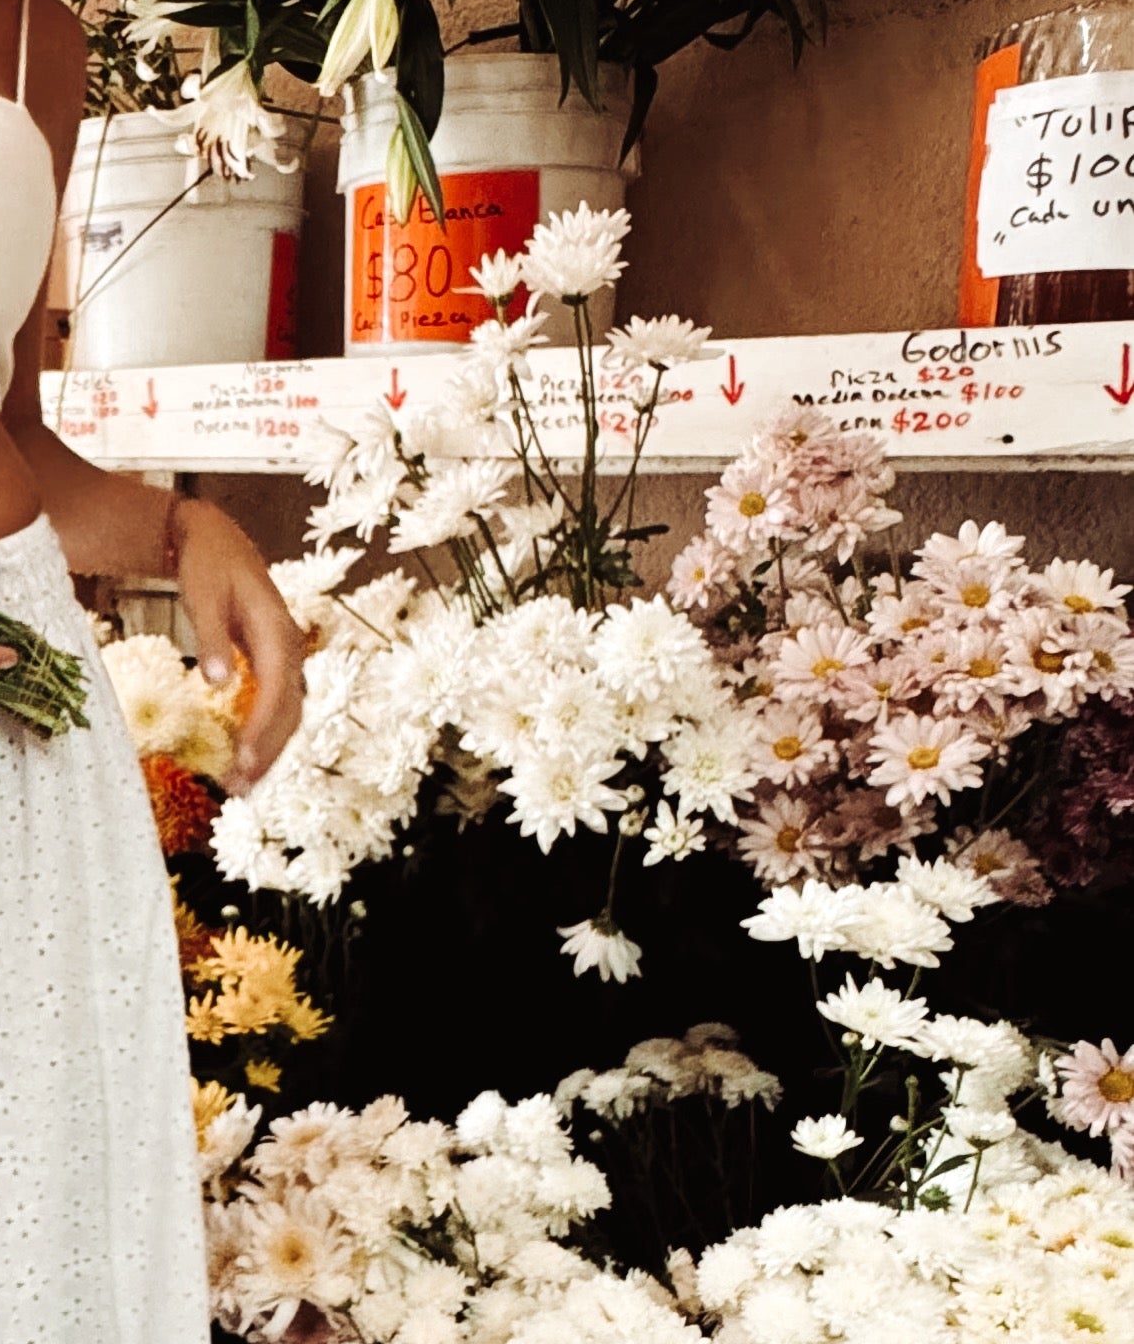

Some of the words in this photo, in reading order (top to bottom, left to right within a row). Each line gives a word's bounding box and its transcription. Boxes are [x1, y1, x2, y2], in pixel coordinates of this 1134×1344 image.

[419, 194, 503, 224] Banca
[366, 243, 453, 303] $80
[917, 367, 974, 383] $20
[961, 383, 1024, 404] $100
[891, 407, 971, 434] $200
